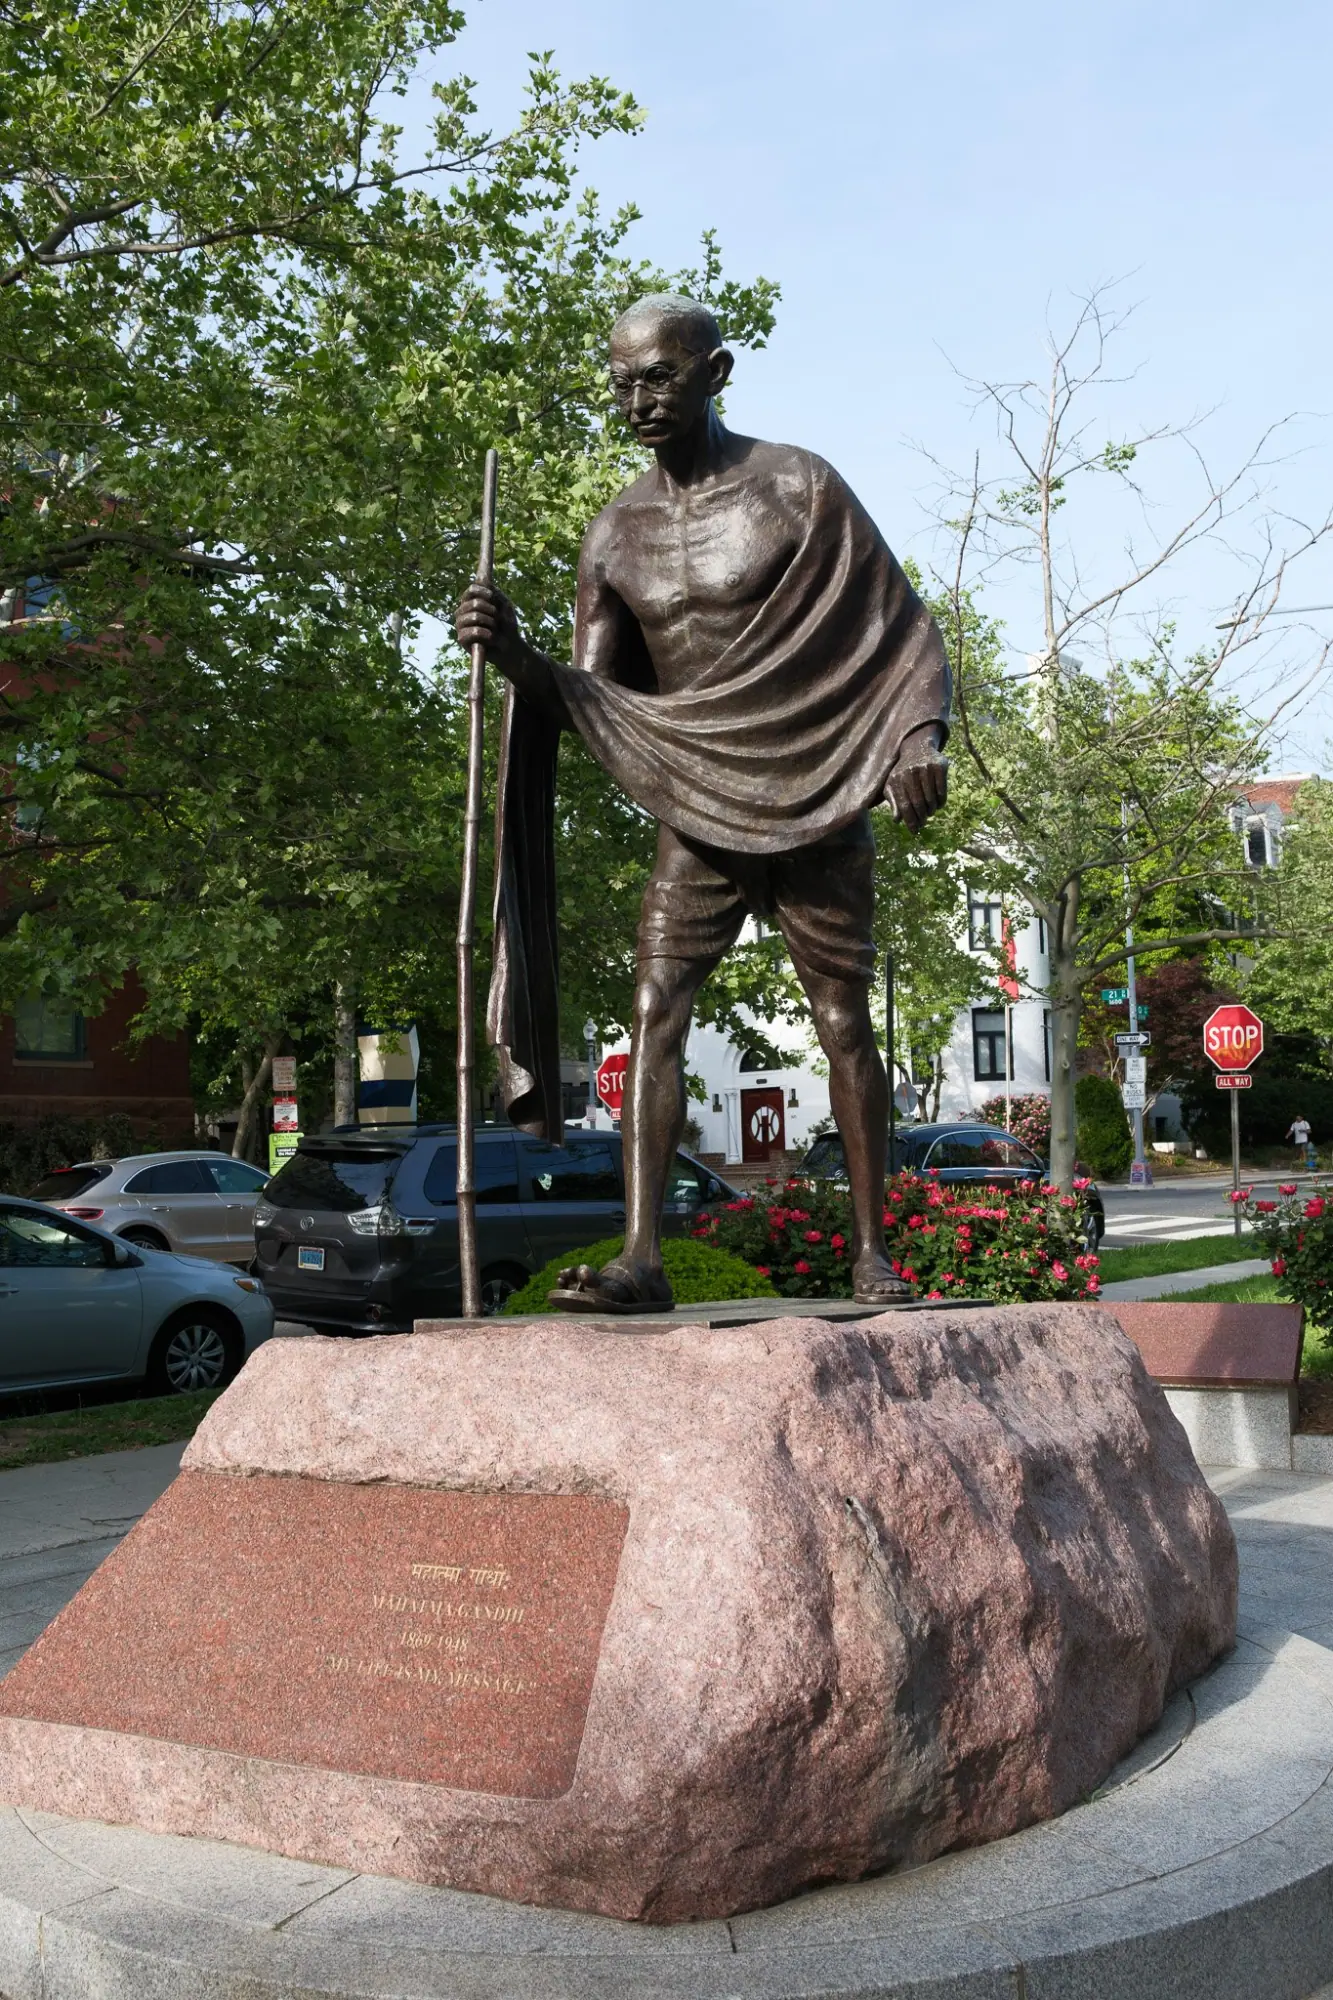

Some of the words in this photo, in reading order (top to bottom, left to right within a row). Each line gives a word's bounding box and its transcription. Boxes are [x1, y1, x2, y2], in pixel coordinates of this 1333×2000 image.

[1108, 990, 1118, 999] 21
[1208, 1025, 1259, 1051] STOP
[600, 1071, 626, 1093] STO
[1218, 1078, 1232, 1086] ALL
[1234, 1077, 1249, 1086] WAY
[372, 1595, 454, 1617] MAHATMA
[457, 1602, 525, 1624] GANDHI
[356, 1659, 394, 1678] LIFE
[398, 1665, 412, 1680] IS
